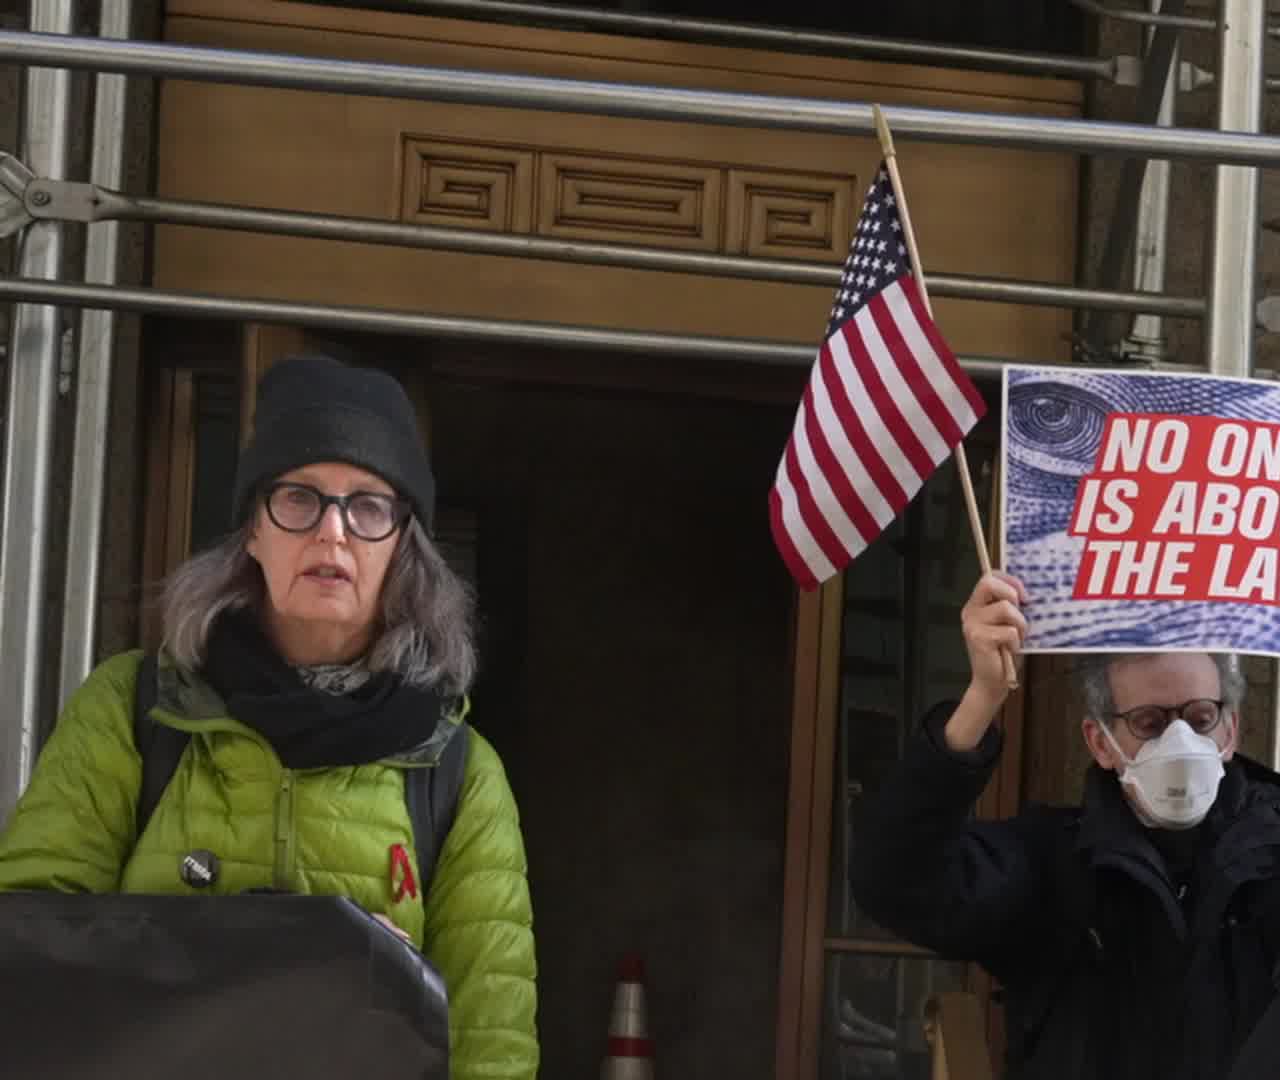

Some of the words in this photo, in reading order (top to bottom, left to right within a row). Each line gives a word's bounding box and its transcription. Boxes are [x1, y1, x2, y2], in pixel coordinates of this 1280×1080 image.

[1102, 418, 1189, 474] NO
[1075, 479, 1138, 534] IS
[1084, 540, 1194, 597] THE
